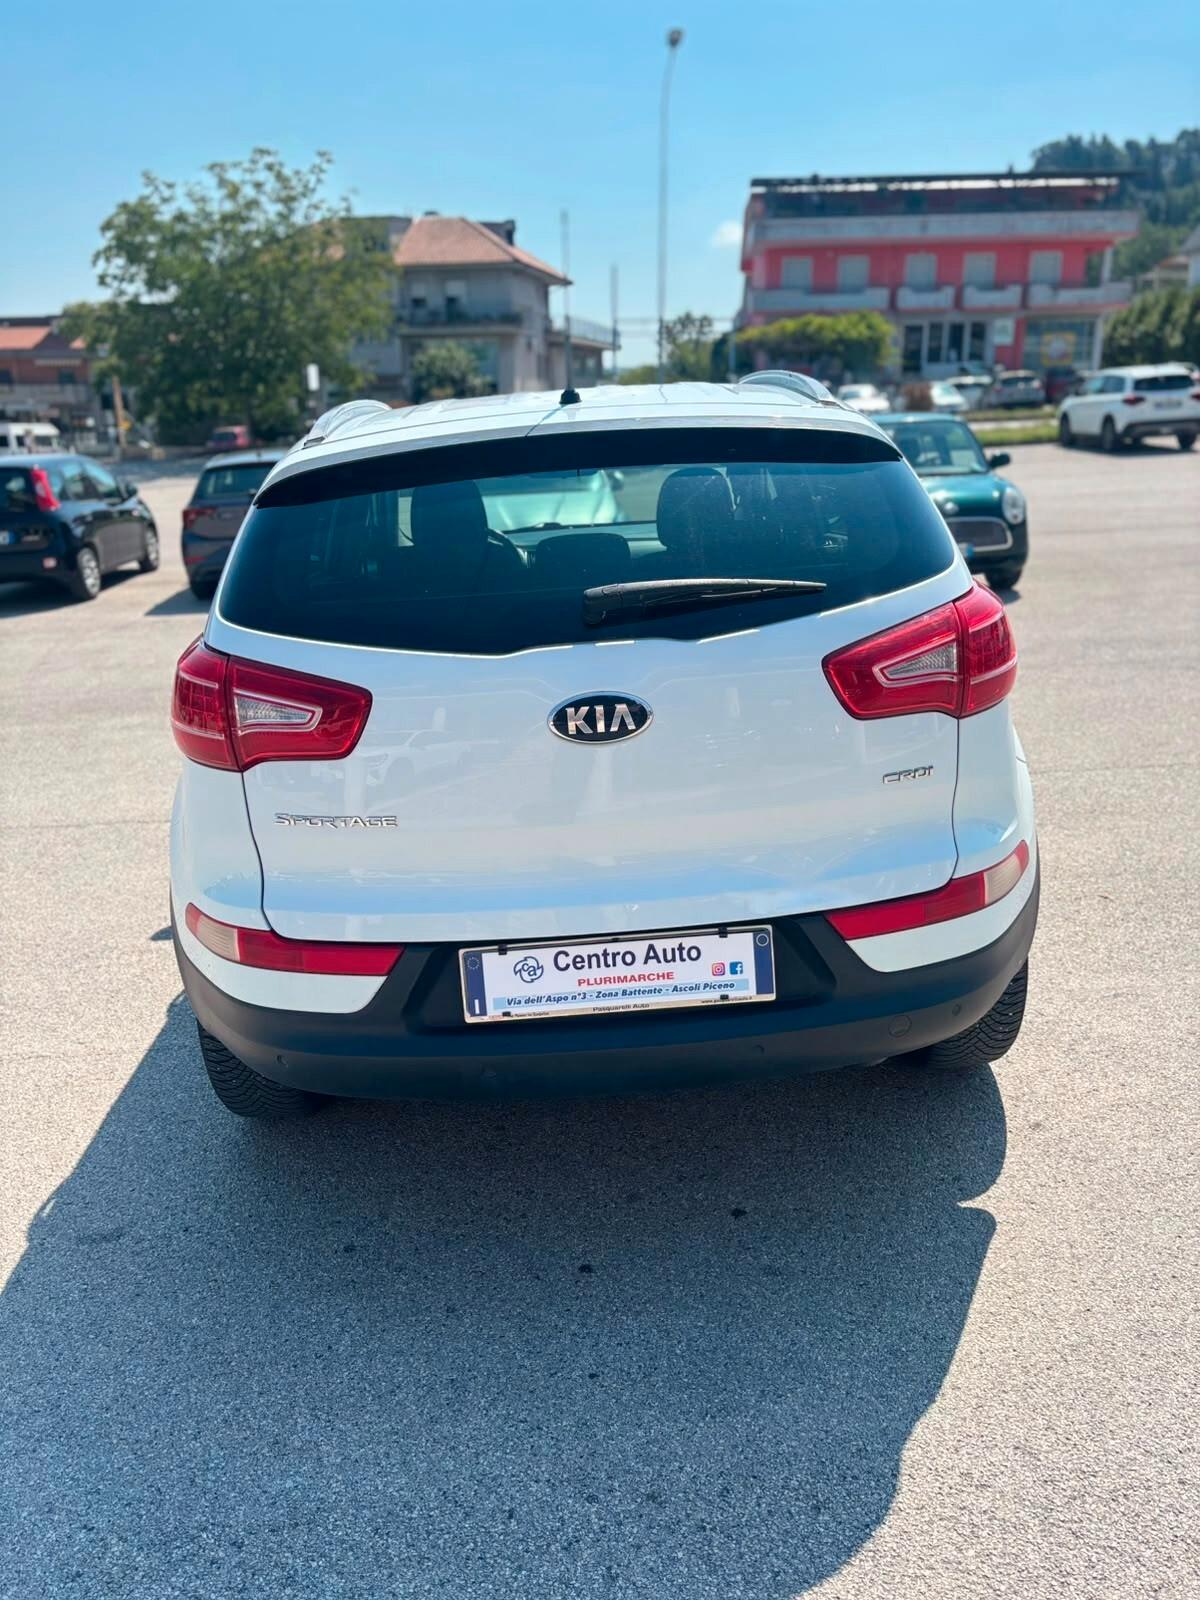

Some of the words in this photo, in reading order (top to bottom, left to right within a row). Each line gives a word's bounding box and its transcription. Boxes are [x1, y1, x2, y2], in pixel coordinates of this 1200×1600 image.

[565, 703, 636, 735] KIA
[553, 947, 636, 972] Centro
[643, 941, 702, 965] Auto
[577, 971, 675, 987] PLURIMARCHE
[507, 997, 522, 1006] Via
[524, 994, 569, 1005] dell'Aspo
[595, 990, 619, 999] Zona
[621, 985, 663, 997] Battente
[672, 983, 700, 993] Ascoli
[703, 981, 735, 991] Piceno
